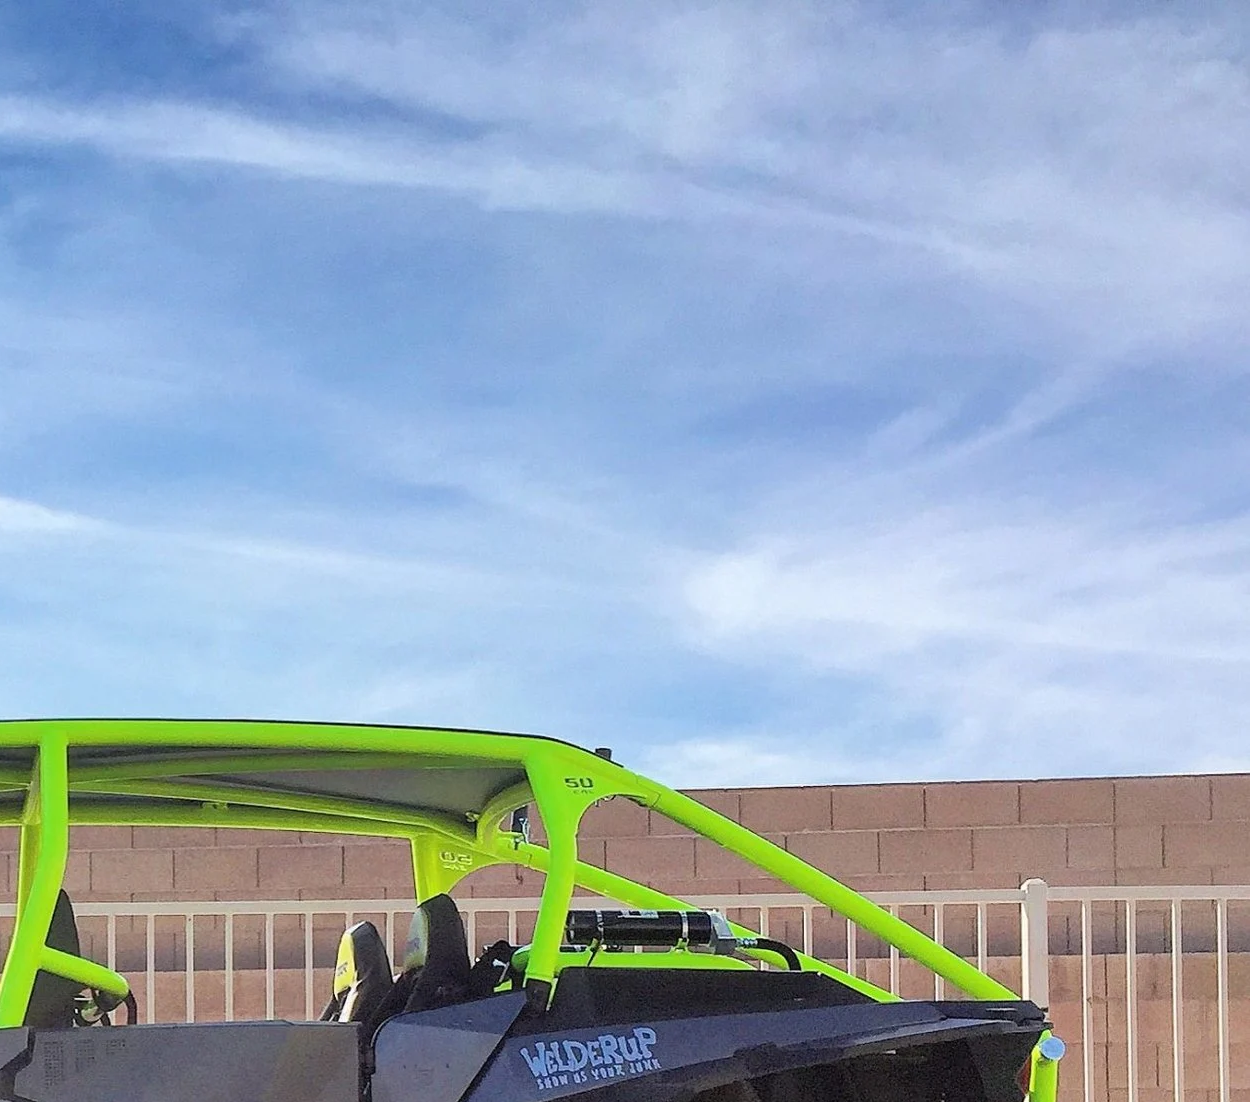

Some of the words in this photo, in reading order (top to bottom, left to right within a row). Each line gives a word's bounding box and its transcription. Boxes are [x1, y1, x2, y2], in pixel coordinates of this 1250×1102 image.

[564, 777, 594, 788] 50
[536, 1074, 569, 1090] SHOW
[573, 1070, 588, 1083] US
[591, 1064, 626, 1081] YOUR
[629, 1058, 662, 1074] JUNK
